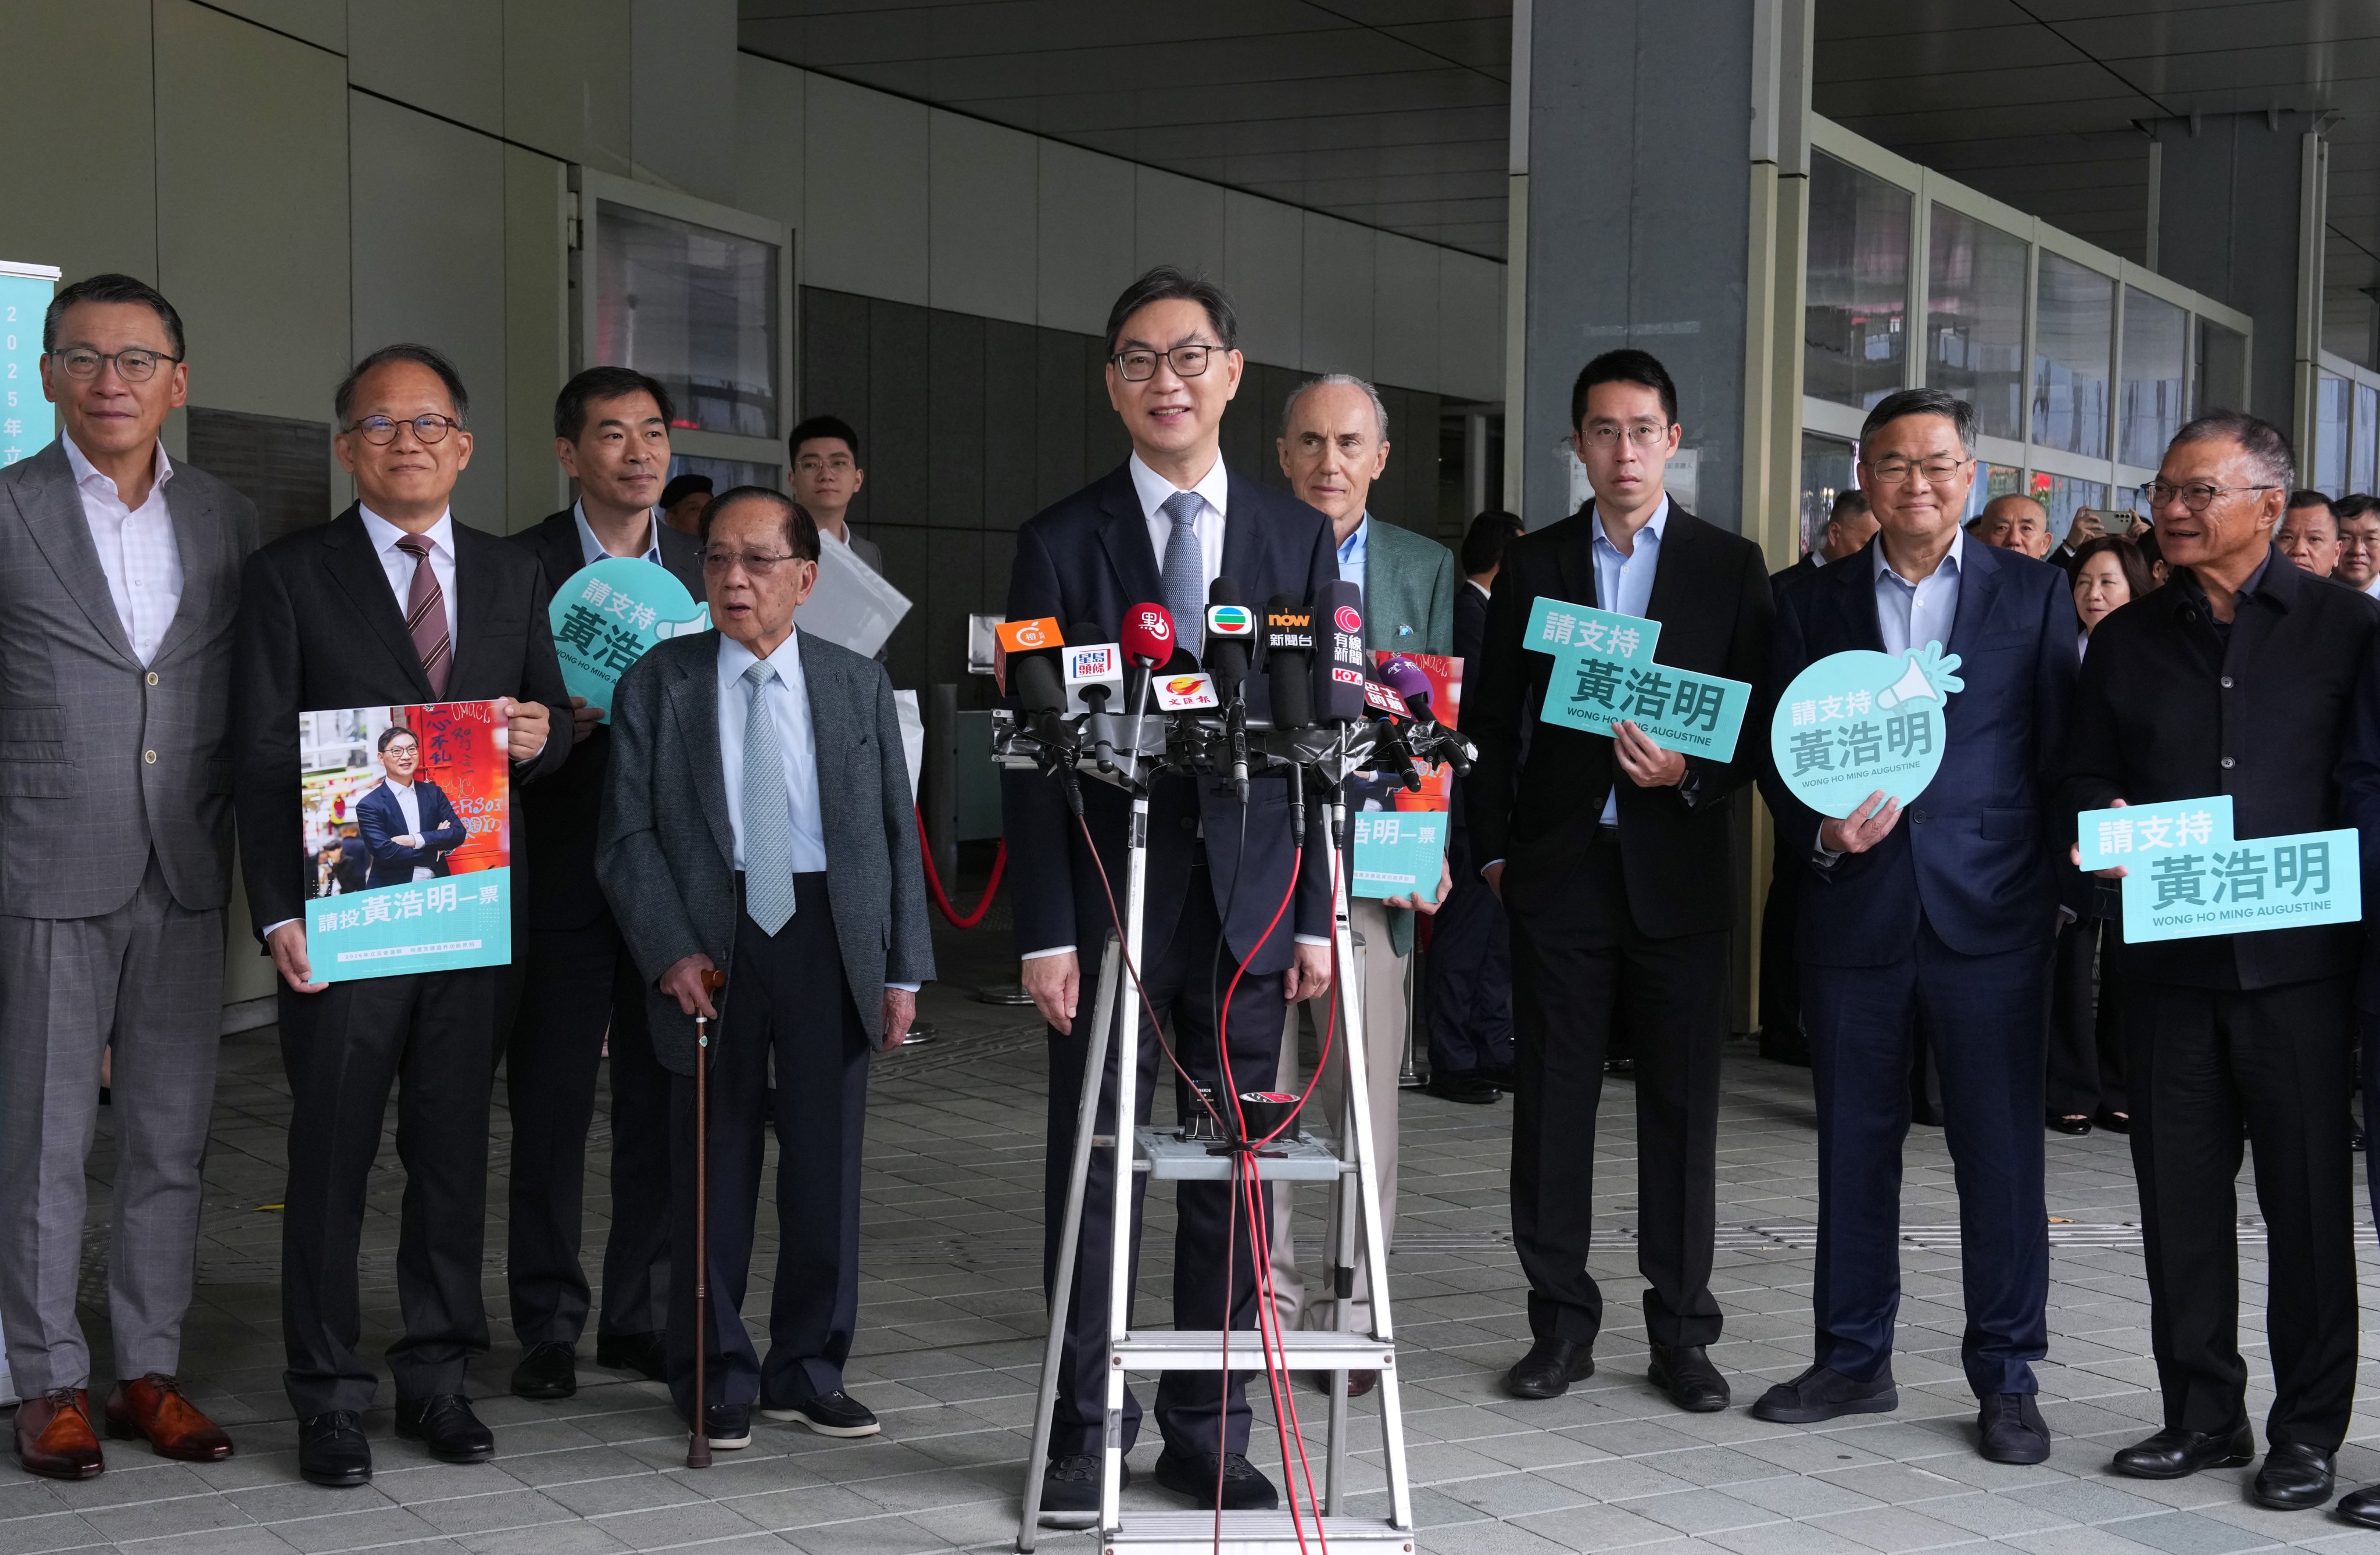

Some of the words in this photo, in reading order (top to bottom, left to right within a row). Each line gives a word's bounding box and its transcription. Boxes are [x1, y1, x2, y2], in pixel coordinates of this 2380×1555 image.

[581, 577, 657, 630] 請支持
[1268, 614, 1311, 627] now
[1542, 611, 1640, 658] 請支持
[1270, 634, 1312, 646] 新聞台
[1334, 632, 1362, 652] 有線
[555, 649, 578, 664] WONG
[579, 660, 590, 671] HO
[590, 667, 610, 681] MING
[1079, 651, 1105, 664] 星島
[1079, 662, 1105, 675] 頭條
[1334, 646, 1362, 666] 新聞
[1335, 669, 1358, 682] HOY
[1169, 695, 1211, 706] 文匯報
[1570, 658, 1726, 732] 黃浩明
[1791, 689, 1872, 727] 請支持
[1567, 707, 1600, 721] WONG
[1602, 714, 1619, 724] HO
[1651, 725, 1712, 746] AUGUSTINE
[1790, 710, 1932, 778] 黃浩明
[1802, 777, 1830, 788] WONG
[1831, 774, 1845, 783] HO
[1846, 770, 1869, 781] MING
[1871, 761, 1921, 776] AUGUSTINE
[2098, 809, 2213, 855] 請支持
[2150, 841, 2331, 911] 黃浩明
[318, 883, 499, 934] 請投黃浩明一票
[2153, 913, 2193, 927] WONG
[2197, 911, 2216, 923] HO
[2220, 907, 2254, 920] MING
[2257, 900, 2332, 917] AUGUSTINE
